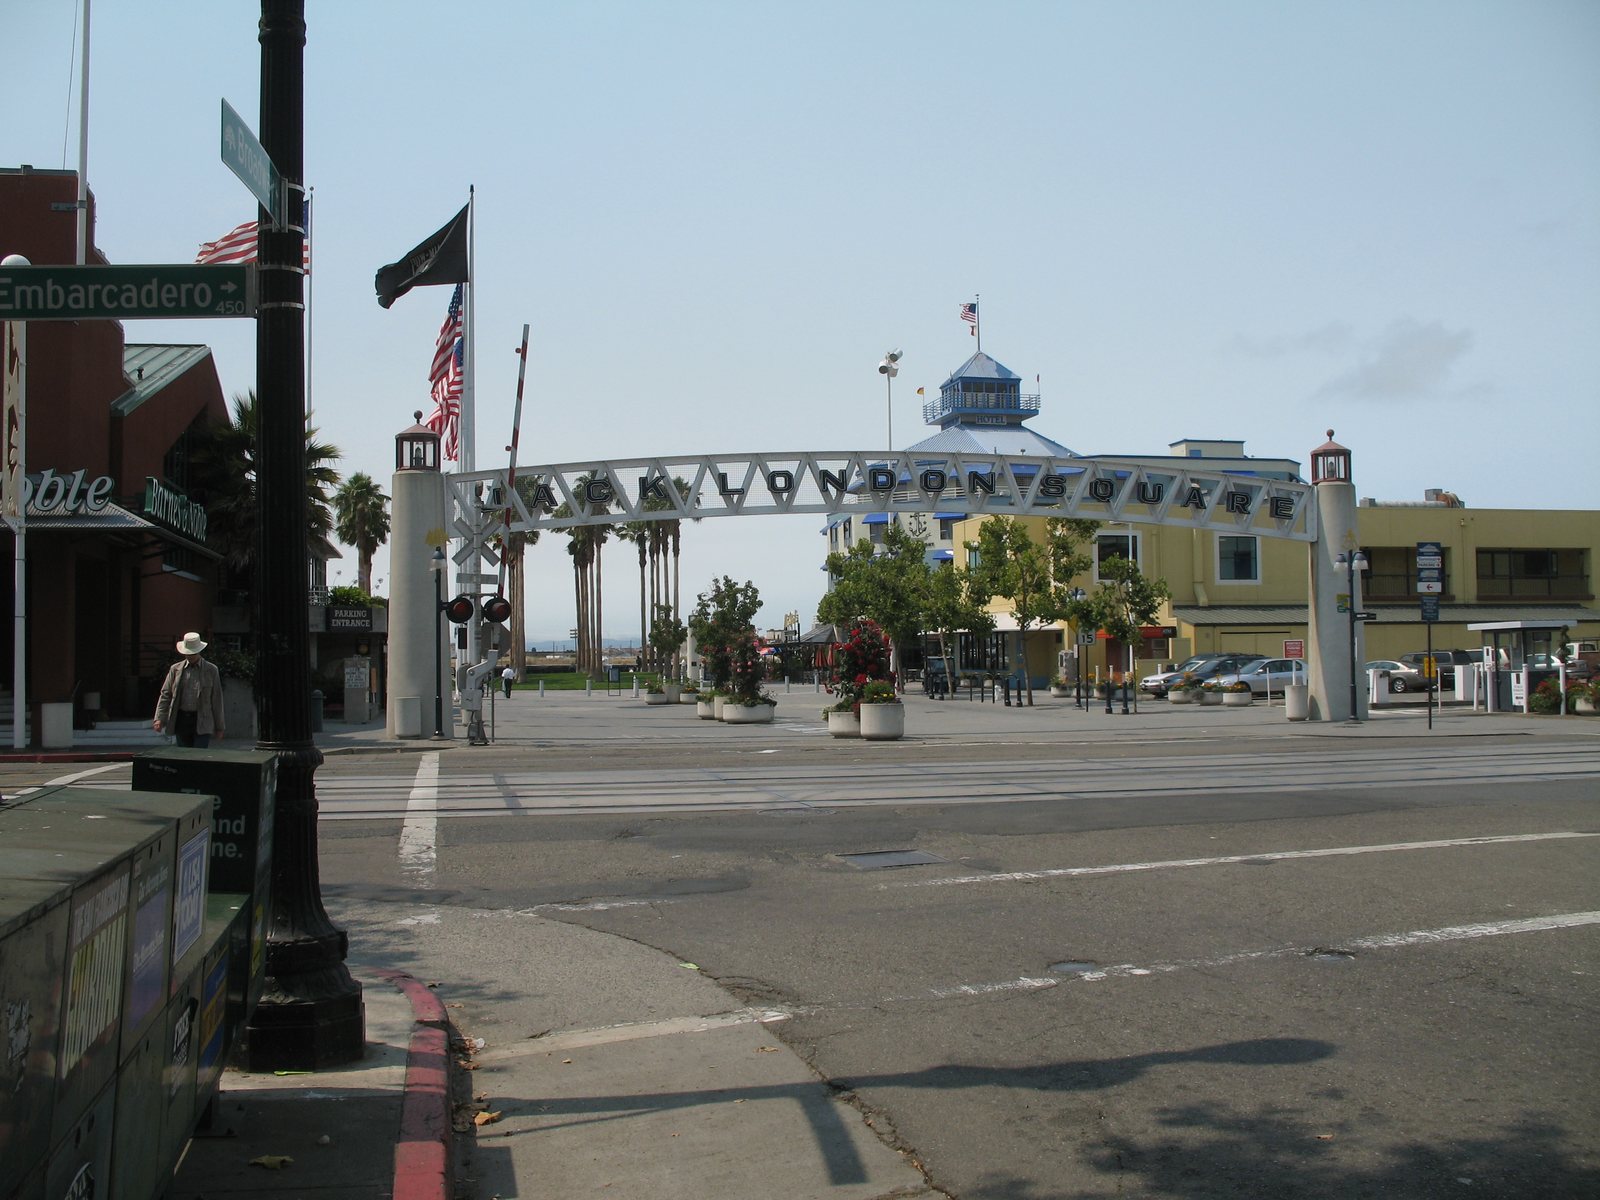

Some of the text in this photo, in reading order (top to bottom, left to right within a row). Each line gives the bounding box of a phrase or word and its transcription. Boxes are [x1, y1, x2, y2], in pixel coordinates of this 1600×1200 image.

[0, 277, 212, 310] Embarcadero
[215, 300, 245, 315] 450
[977, 416, 1006, 424] HOTEL
[718, 468, 996, 497] LONDON
[1041, 475, 1295, 519] SQUARE
[151, 477, 182, 530] Barnes
[334, 609, 367, 618] PARKING
[331, 619, 371, 627] ENTRANCE
[1081, 634, 1094, 643] 15
[61, 911, 127, 1080] GUARDIAN
